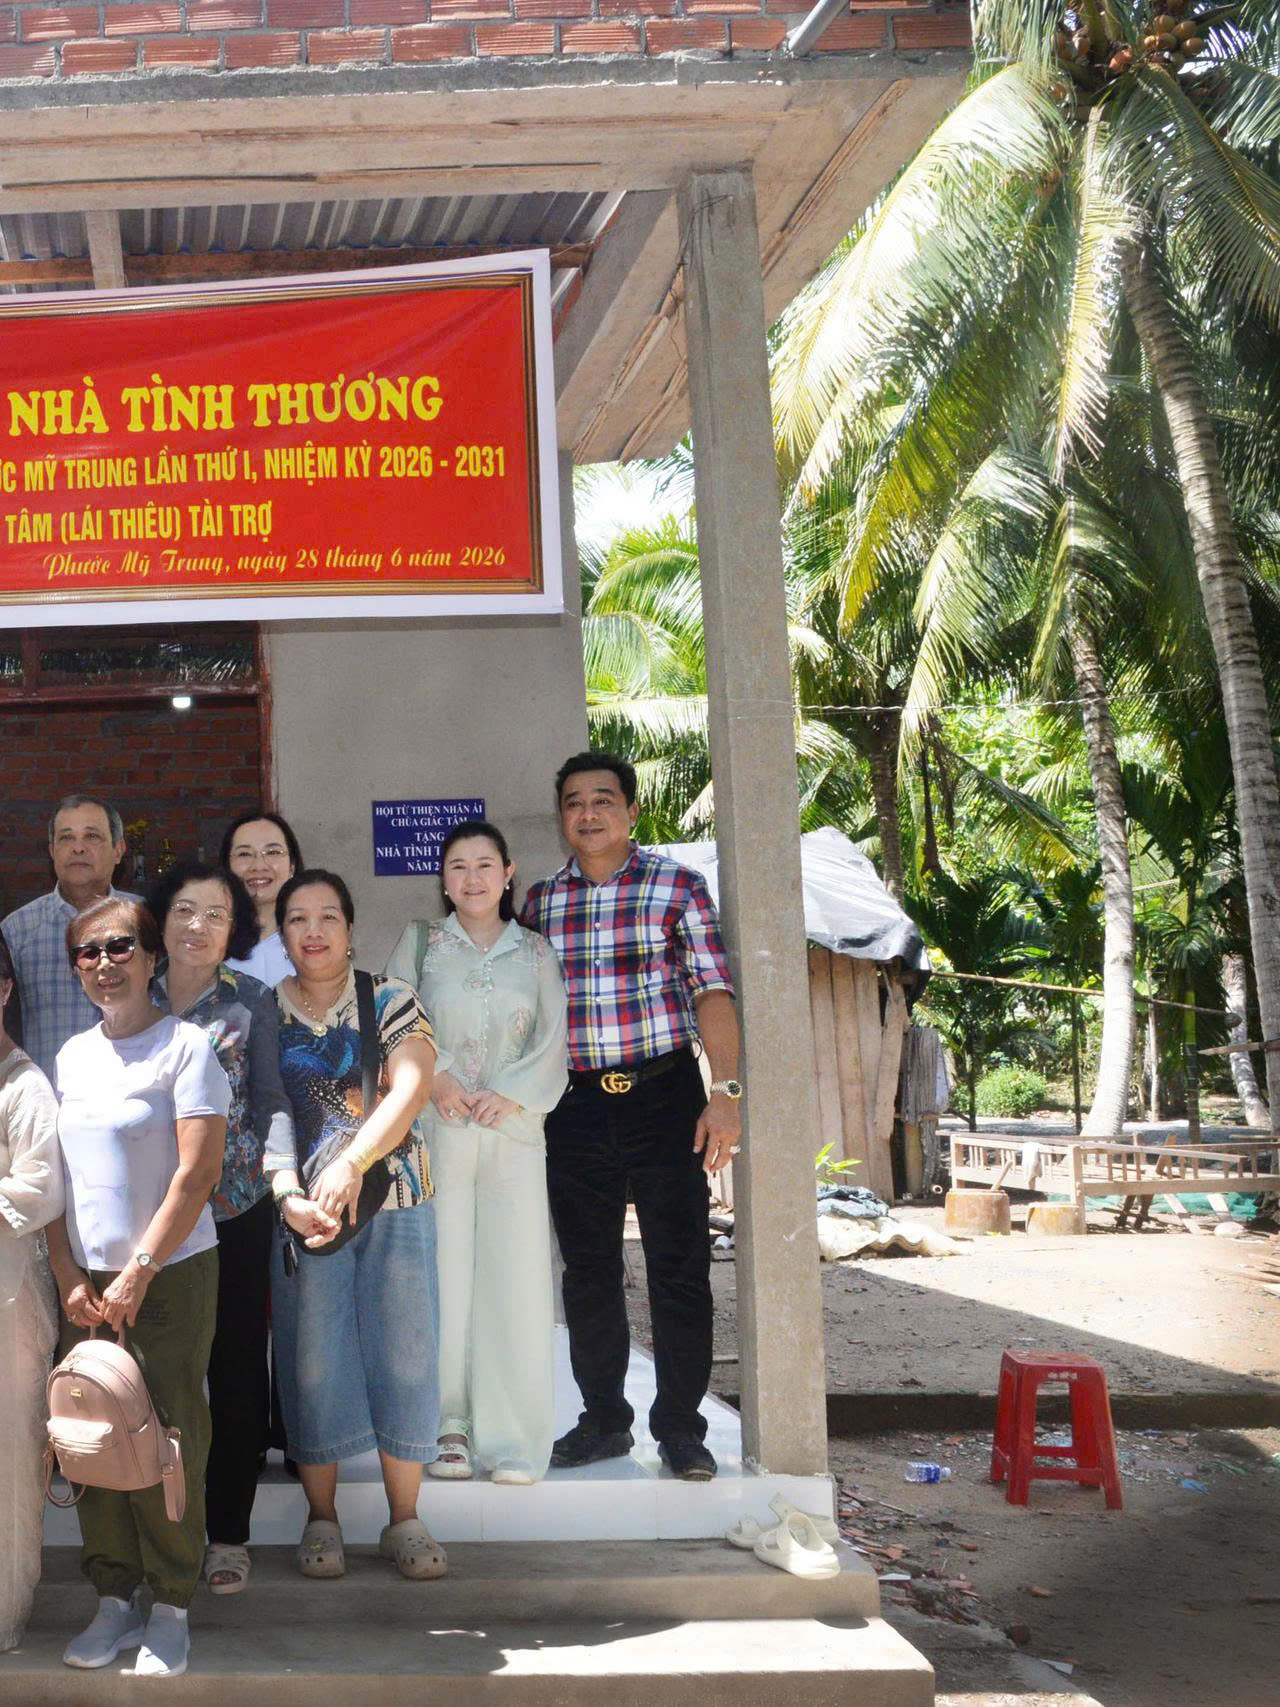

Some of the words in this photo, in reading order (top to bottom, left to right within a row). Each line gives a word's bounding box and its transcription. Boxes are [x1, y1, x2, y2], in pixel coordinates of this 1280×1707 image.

[8, 376, 109, 436] NHÀ
[121, 373, 235, 432] TÌNH
[247, 372, 443, 427] THƯƠNG
[24, 454, 58, 492] MỸ
[64, 457, 137, 489] TRUNG
[145, 445, 187, 485] LẦN
[194, 446, 238, 481] THỨ
[243, 450, 257, 483] I,
[264, 440, 337, 485] NHIỆM
[345, 440, 372, 478] KỲ
[380, 446, 432, 477] 2026
[456, 446, 504, 477] 2031
[5, 508, 52, 544] TÂM
[61, 504, 102, 544] (LÁI
[109, 501, 181, 541] THIÊU)
[188, 499, 223, 537] TÀI
[230, 500, 272, 542] TRỢ
[237, 551, 287, 575] ngày
[295, 549, 318, 569] 28
[325, 545, 383, 572] tháng
[391, 548, 403, 567] 6
[408, 549, 452, 567] năm
[459, 546, 506, 567] 2026
